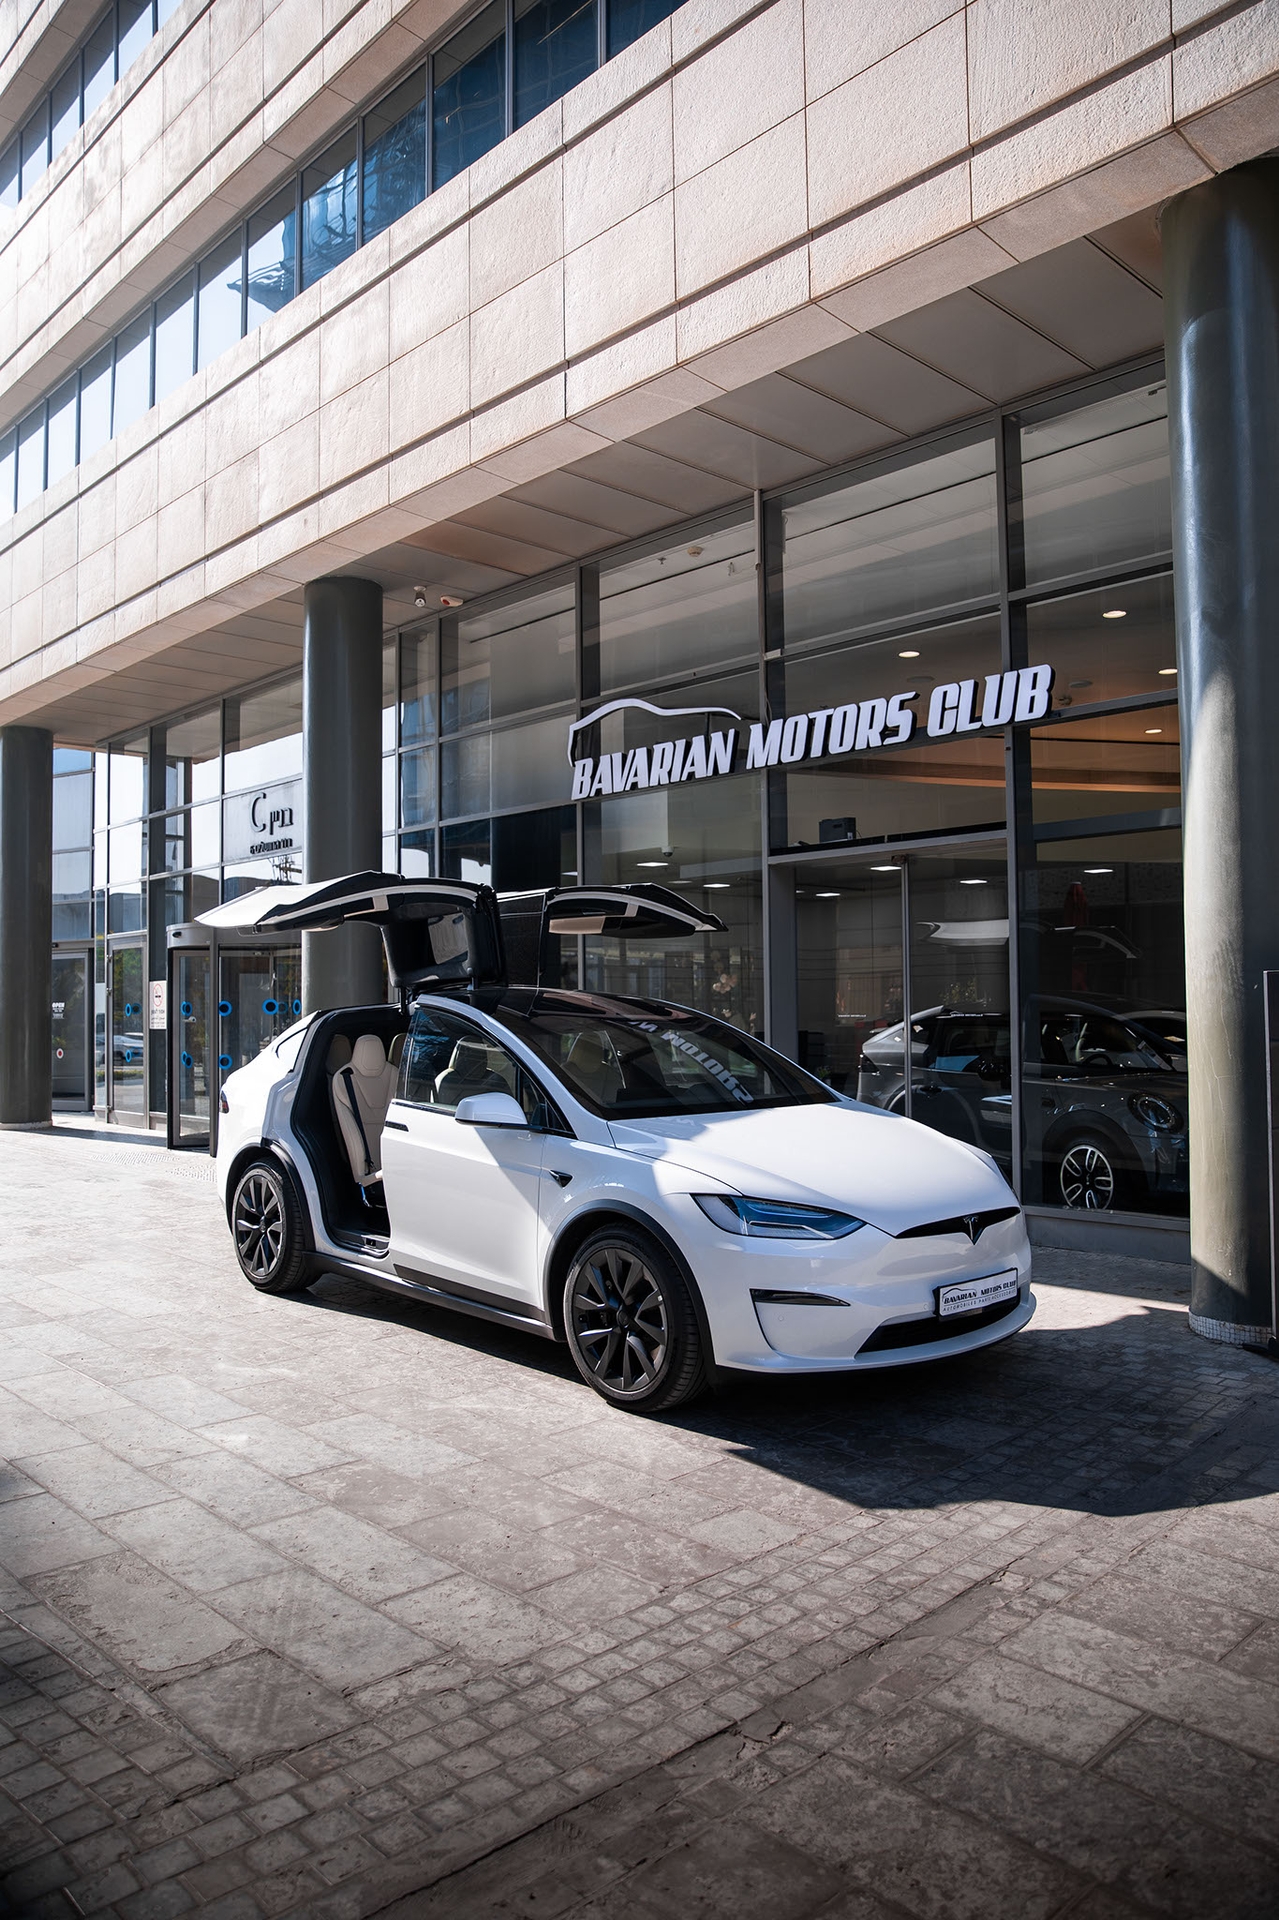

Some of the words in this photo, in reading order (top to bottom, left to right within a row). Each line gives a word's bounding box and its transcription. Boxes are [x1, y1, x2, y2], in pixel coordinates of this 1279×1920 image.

[570, 728, 738, 800] BAVARIAN
[746, 691, 917, 769] MOTORS
[926, 664, 1055, 737] CLUB
[944, 1292, 977, 1304] BAVARIAN
[981, 1284, 1002, 1296] MOTORS
